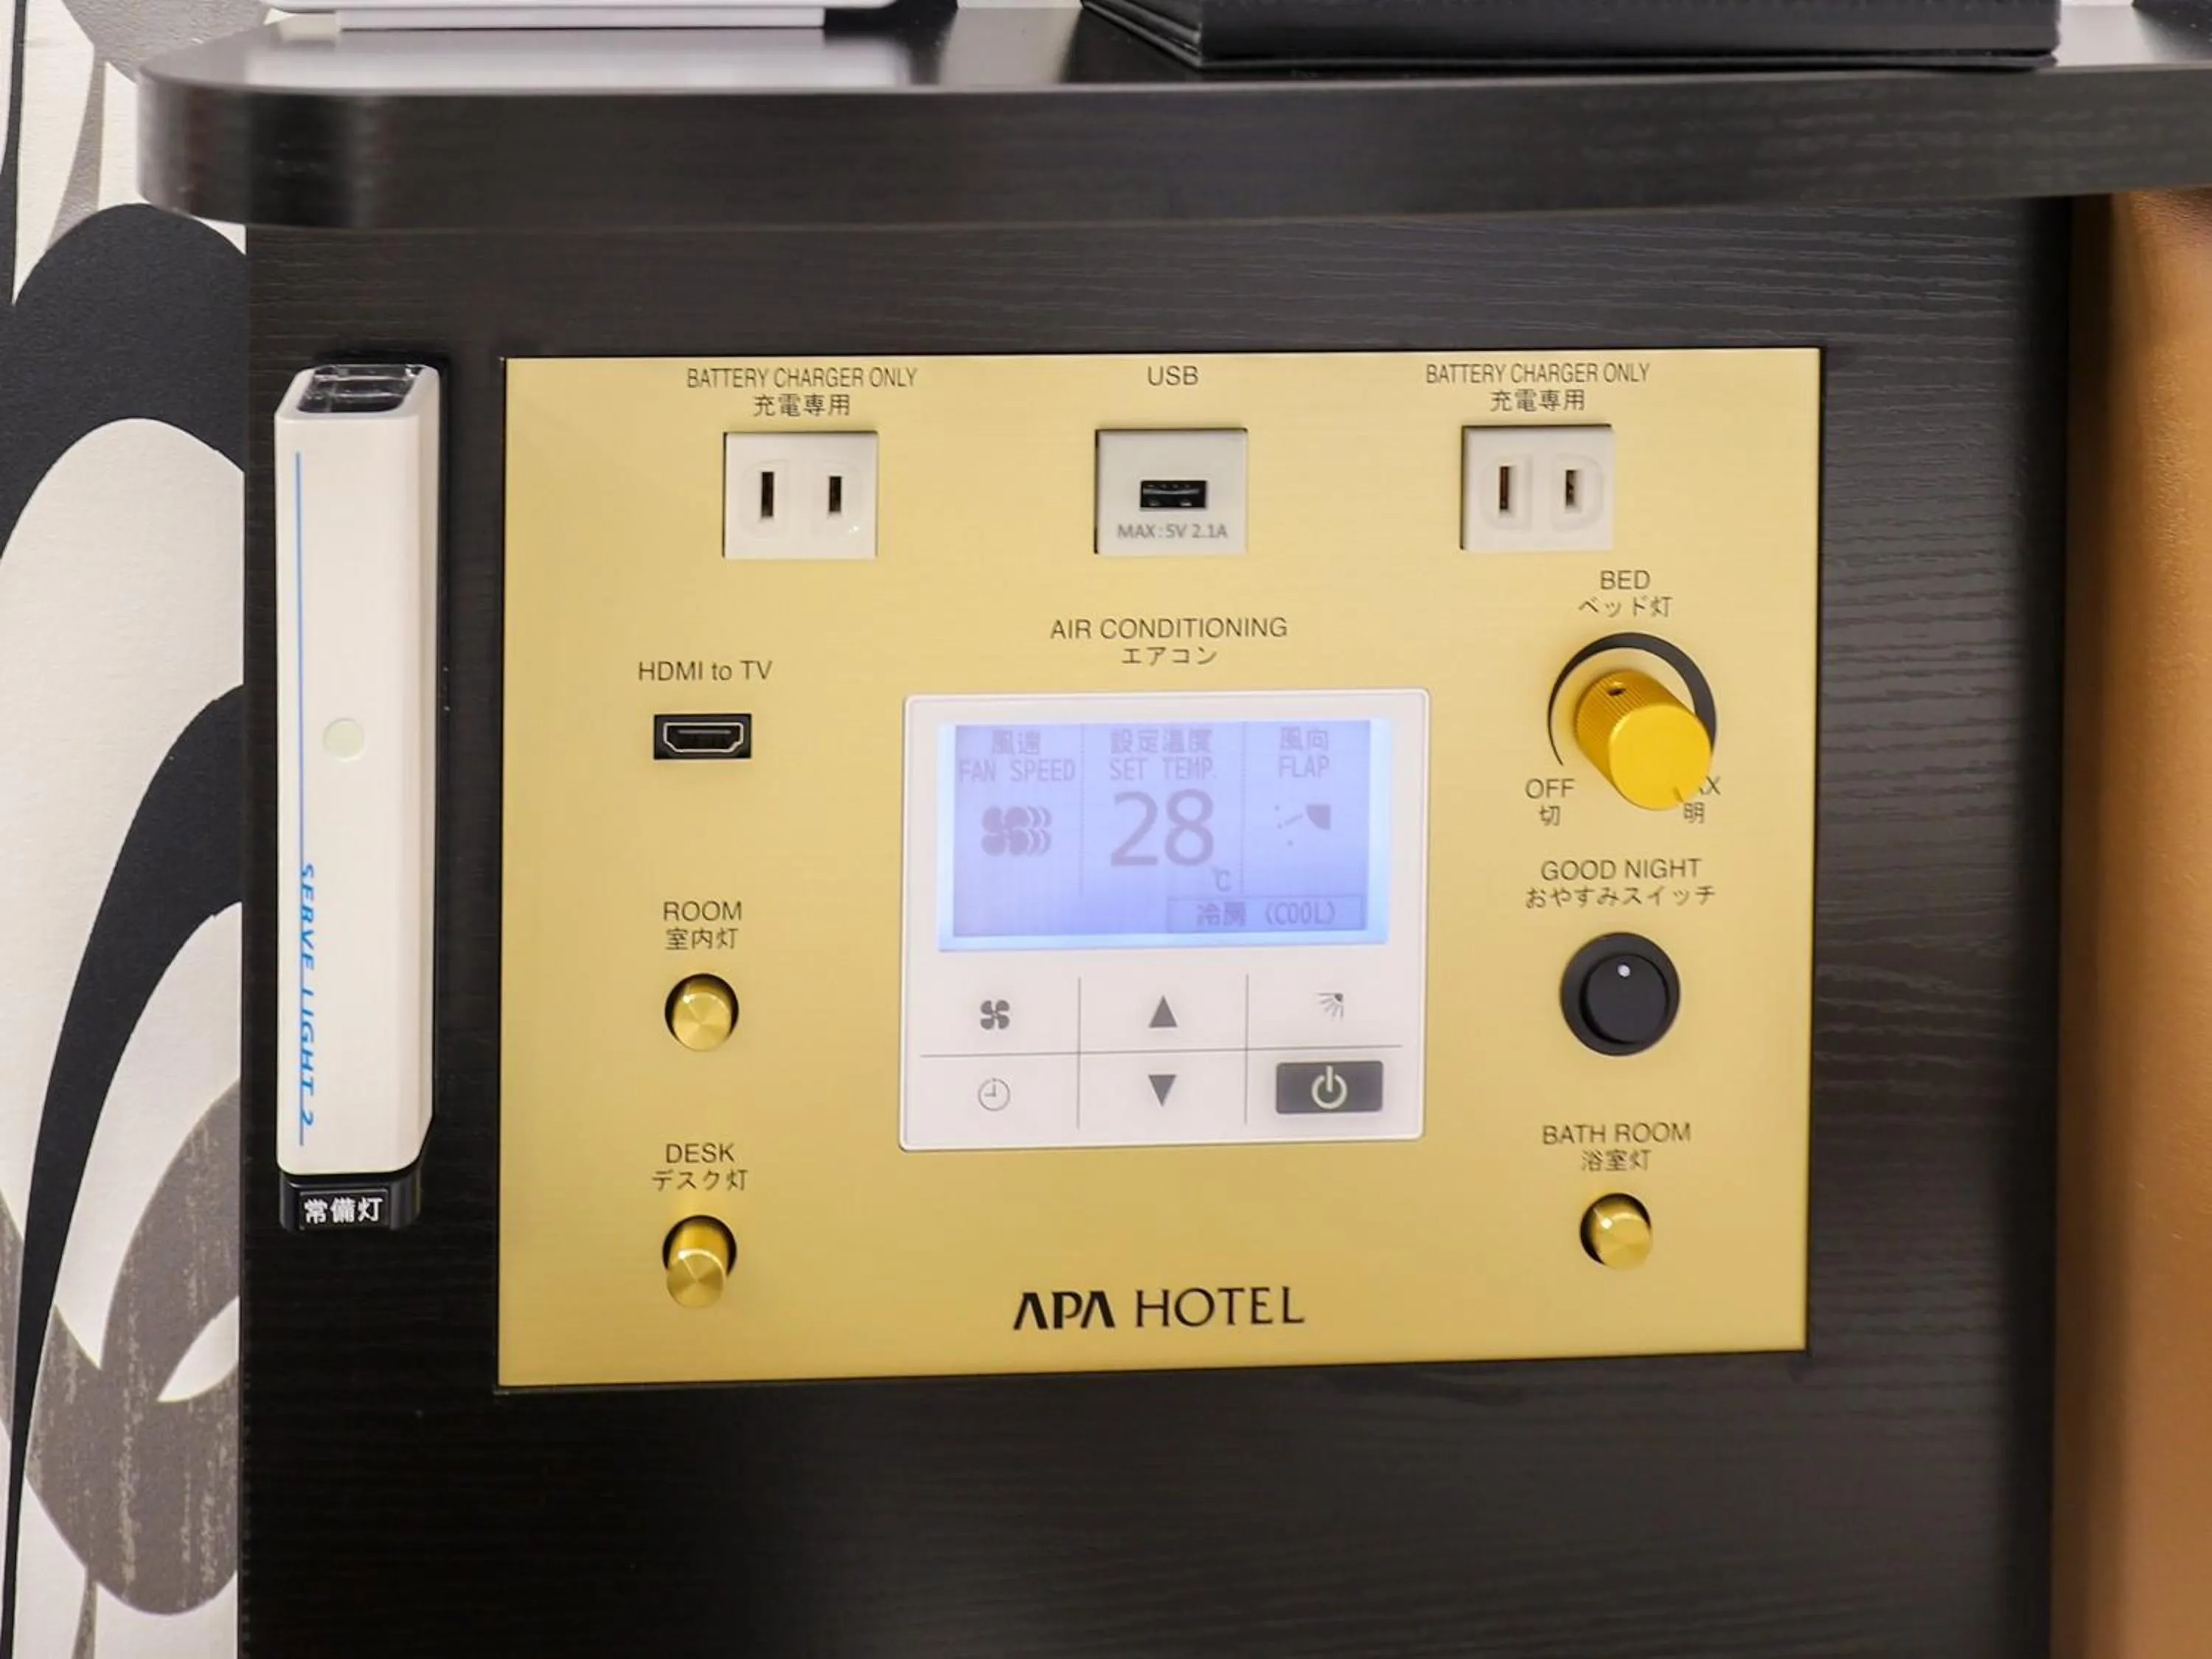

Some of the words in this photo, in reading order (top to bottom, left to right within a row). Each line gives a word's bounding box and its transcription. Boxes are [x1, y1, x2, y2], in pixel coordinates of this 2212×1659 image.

[687, 367, 768, 388] BATTERY
[773, 366, 864, 388] CHARGER
[869, 366, 917, 387] ONLY
[1147, 365, 1199, 386] USB
[1426, 364, 1506, 383] BATTERY
[1510, 363, 1598, 383] CHARGER
[1603, 362, 1650, 382] ONLY
[754, 393, 851, 417] 充電専用
[1490, 389, 1585, 411] 充電専用
[1192, 523, 1228, 539] 2.1A
[1601, 571, 1650, 591] BED
[1578, 597, 1672, 618] ベッド灯
[1051, 619, 1092, 640] AIR
[1100, 618, 1288, 640] CONDITIONING
[1121, 646, 1218, 667] エアコン
[639, 661, 704, 681] HDMI
[710, 662, 733, 681] to
[740, 660, 773, 680] TV
[992, 730, 1041, 756] 風速
[1110, 728, 1213, 754] 設定温度
[1280, 727, 1329, 751] 風向
[959, 760, 996, 783] FAN
[1011, 759, 1075, 782] SPEED
[1110, 758, 1147, 781] SET
[1279, 756, 1329, 779] FLAP
[1525, 778, 1575, 799] OFF
[1539, 805, 1561, 826] 切
[1683, 801, 1705, 824] 明
[1110, 789, 1214, 868] 28
[1540, 860, 1616, 880] GOOD
[1624, 858, 1703, 879] NIGHT
[1525, 885, 1717, 908] おやすみスイッチ
[299, 863, 315, 970] SERVE
[664, 901, 742, 922] ROOM
[1197, 902, 1246, 926] 冷房
[665, 928, 739, 950] 室内灯
[299, 987, 315, 1096] LIGHT
[300, 1113, 314, 1127] 2
[1543, 1124, 1606, 1145] BATH
[1615, 1122, 1691, 1143] ROOM
[665, 1142, 736, 1164] DESK
[1581, 1149, 1652, 1172] 浴室灯
[652, 1169, 749, 1192] デスク灯
[303, 1198, 383, 1224] 常備灯
[1012, 1290, 1116, 1330] APA
[1135, 1286, 1305, 1328] HOTEL
